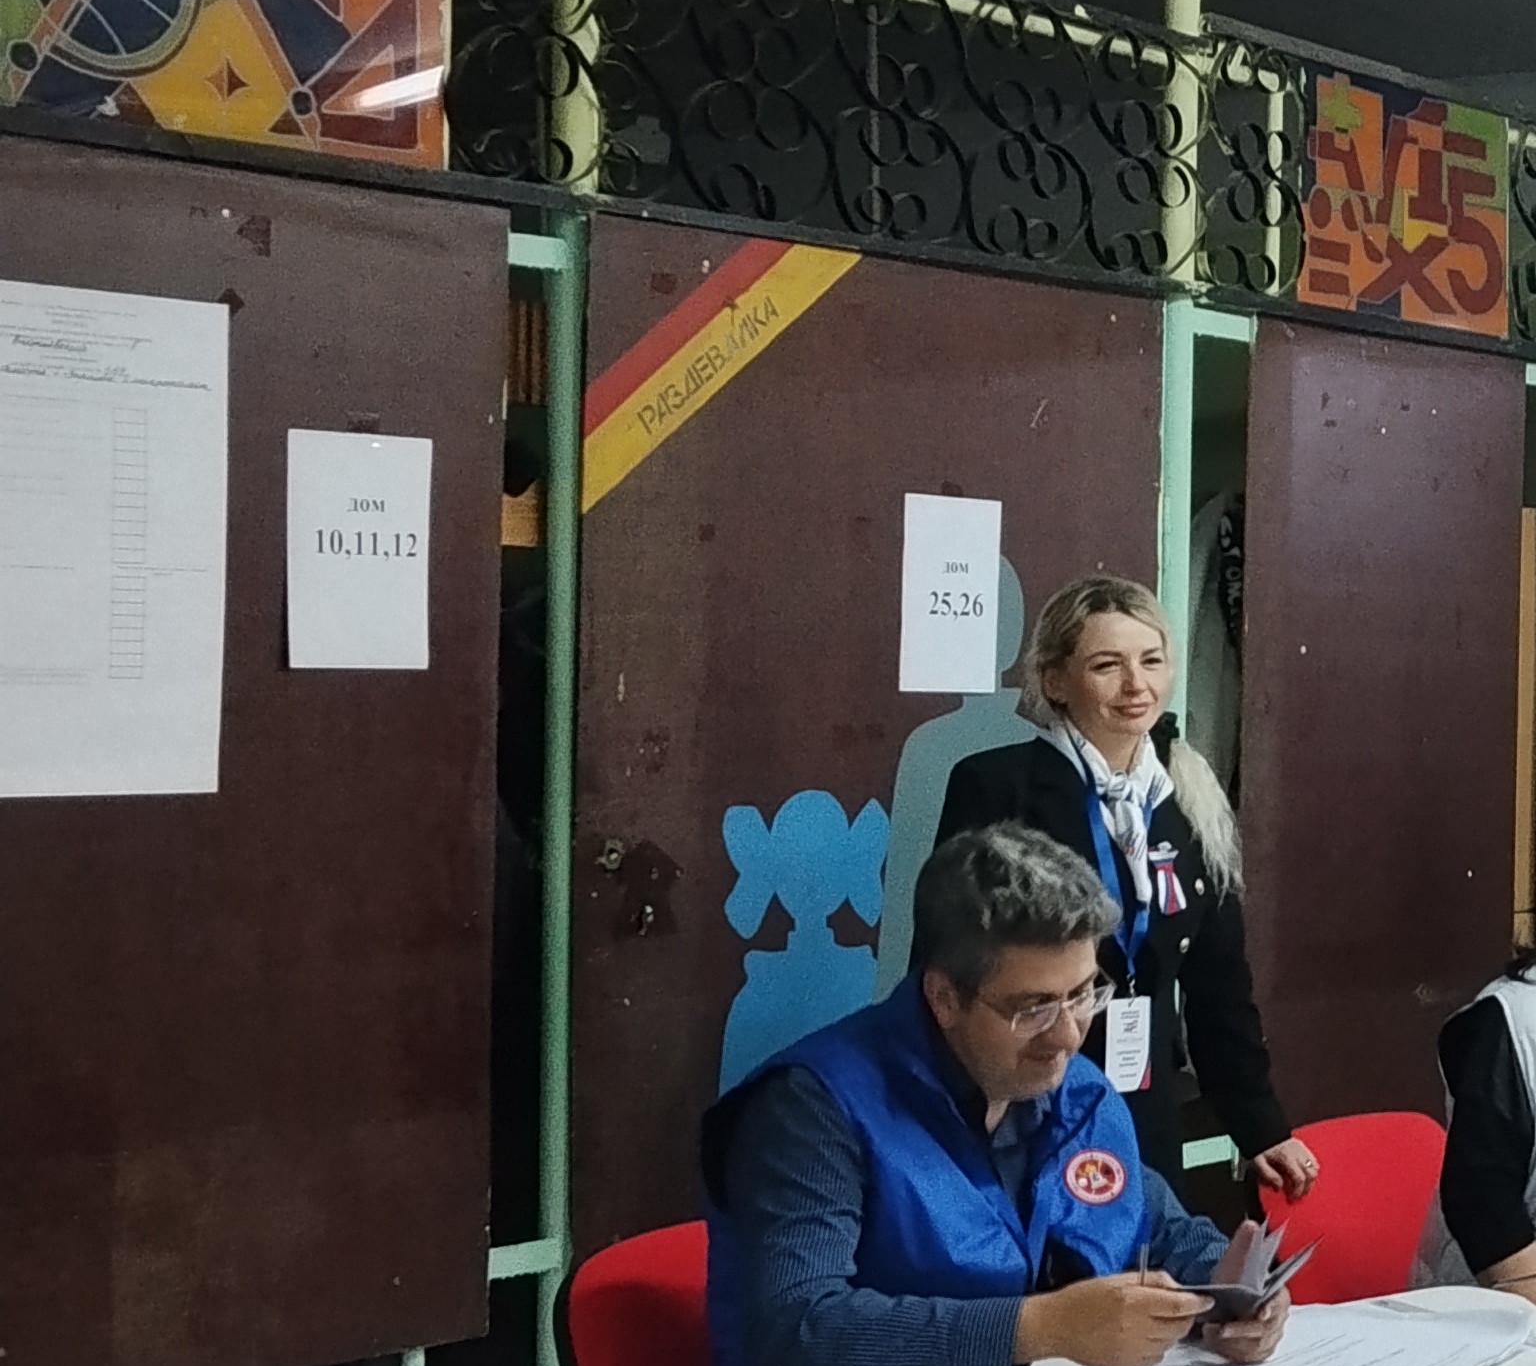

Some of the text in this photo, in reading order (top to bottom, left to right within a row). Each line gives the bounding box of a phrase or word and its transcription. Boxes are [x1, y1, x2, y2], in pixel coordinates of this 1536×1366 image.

[637, 295, 780, 436] РАЗДЕВАЛКА
[347, 497, 386, 513] дом
[315, 528, 418, 561] 10,11,12
[942, 561, 970, 575] дом
[928, 590, 985, 621] 25,26
